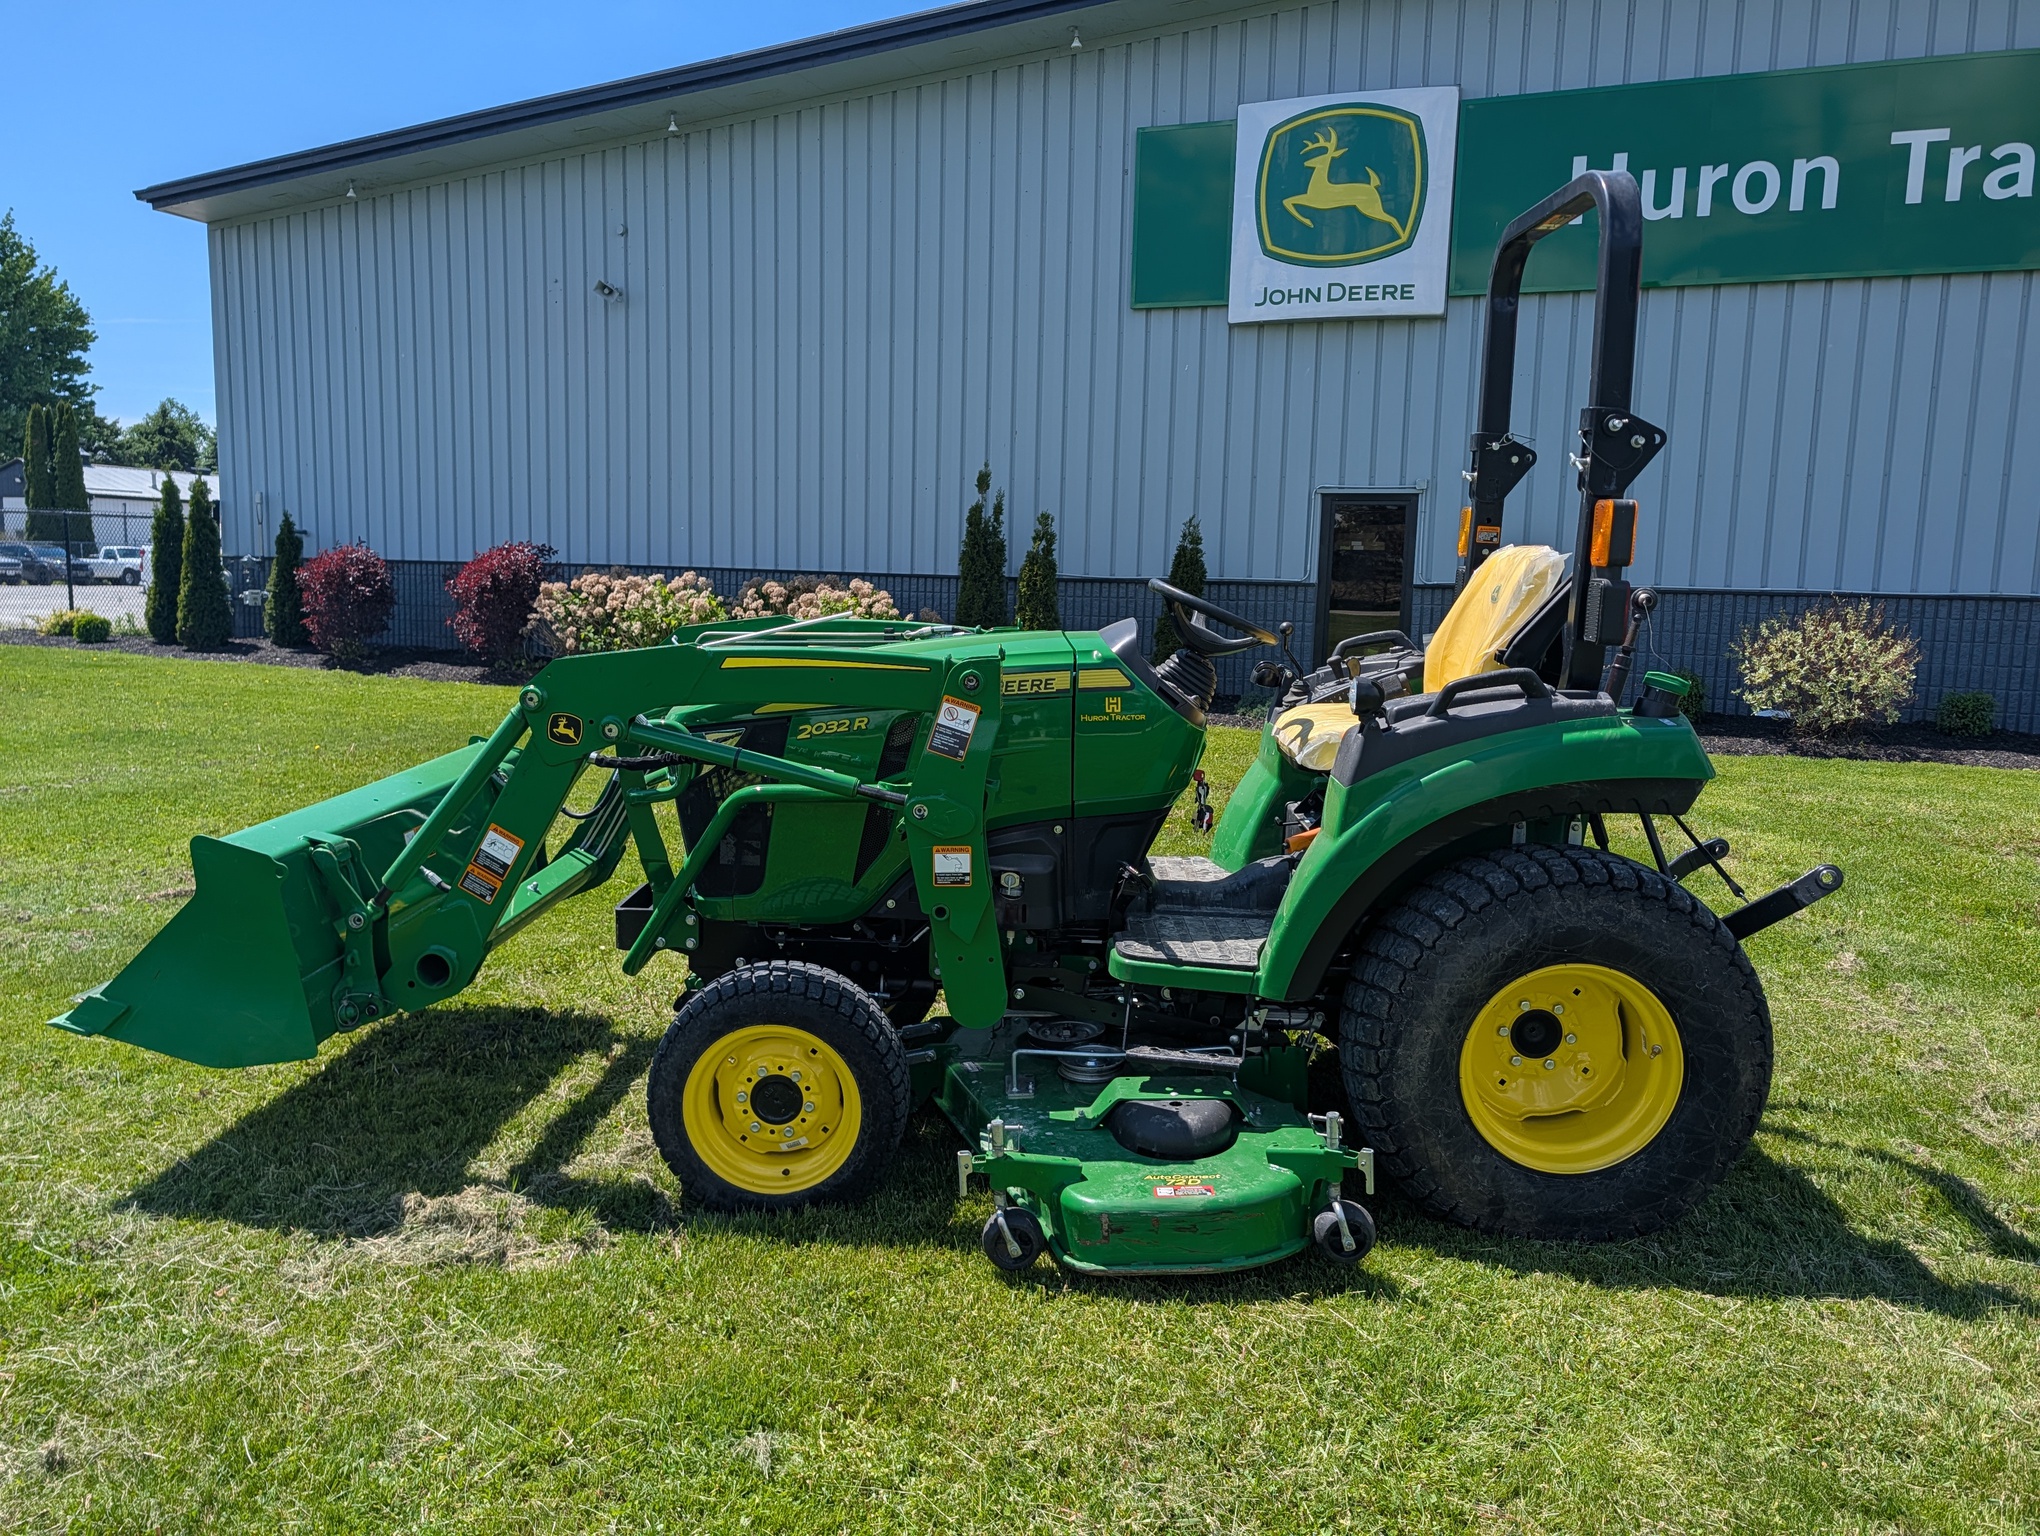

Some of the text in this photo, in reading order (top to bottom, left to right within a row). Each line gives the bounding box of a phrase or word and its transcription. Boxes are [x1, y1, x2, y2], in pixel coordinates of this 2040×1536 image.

[1890, 127, 2036, 205] Tra
[1254, 282, 1416, 307] JOHN DEERE
[1001, 678, 1056, 694] EERE
[949, 698, 979, 712] WARNING
[1080, 713, 1146, 722] HURON TRACTOR
